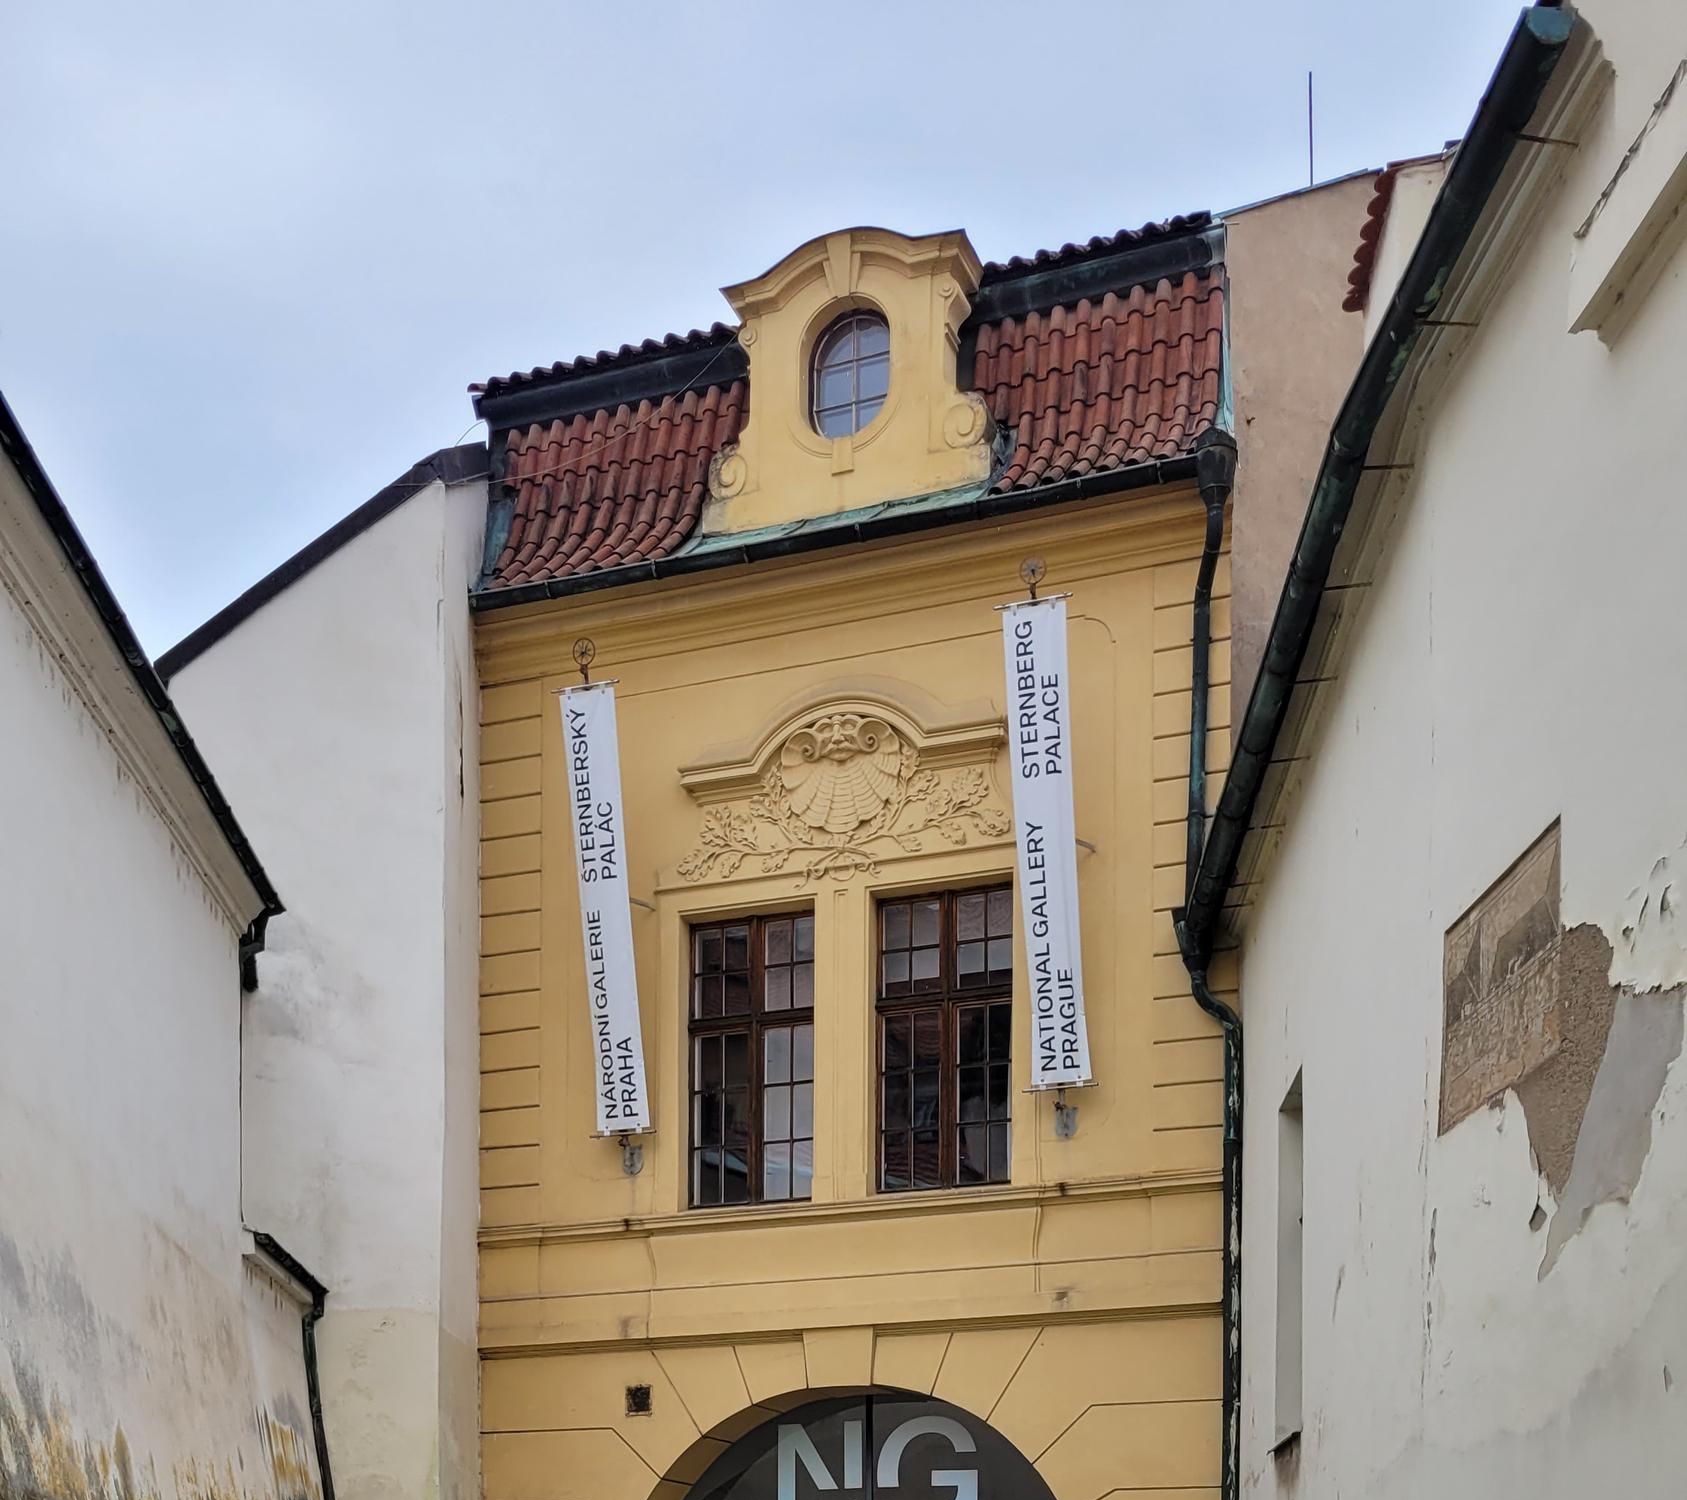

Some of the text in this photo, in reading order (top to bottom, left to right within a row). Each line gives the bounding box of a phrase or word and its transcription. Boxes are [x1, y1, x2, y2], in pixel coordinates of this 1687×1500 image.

[1014, 620, 1040, 779] STERNBERG
[1041, 674, 1062, 775] PALACE
[566, 708, 598, 883] ŠTERNBERSKÝ
[596, 802, 618, 880] PALÁC
[1025, 821, 1058, 1072] NATIONAL GALLERY
[587, 910, 619, 1120] NÁRODNÍ GALERIE
[616, 1036, 639, 1119] PRAHA
[1057, 968, 1081, 1071] PRAGUE
